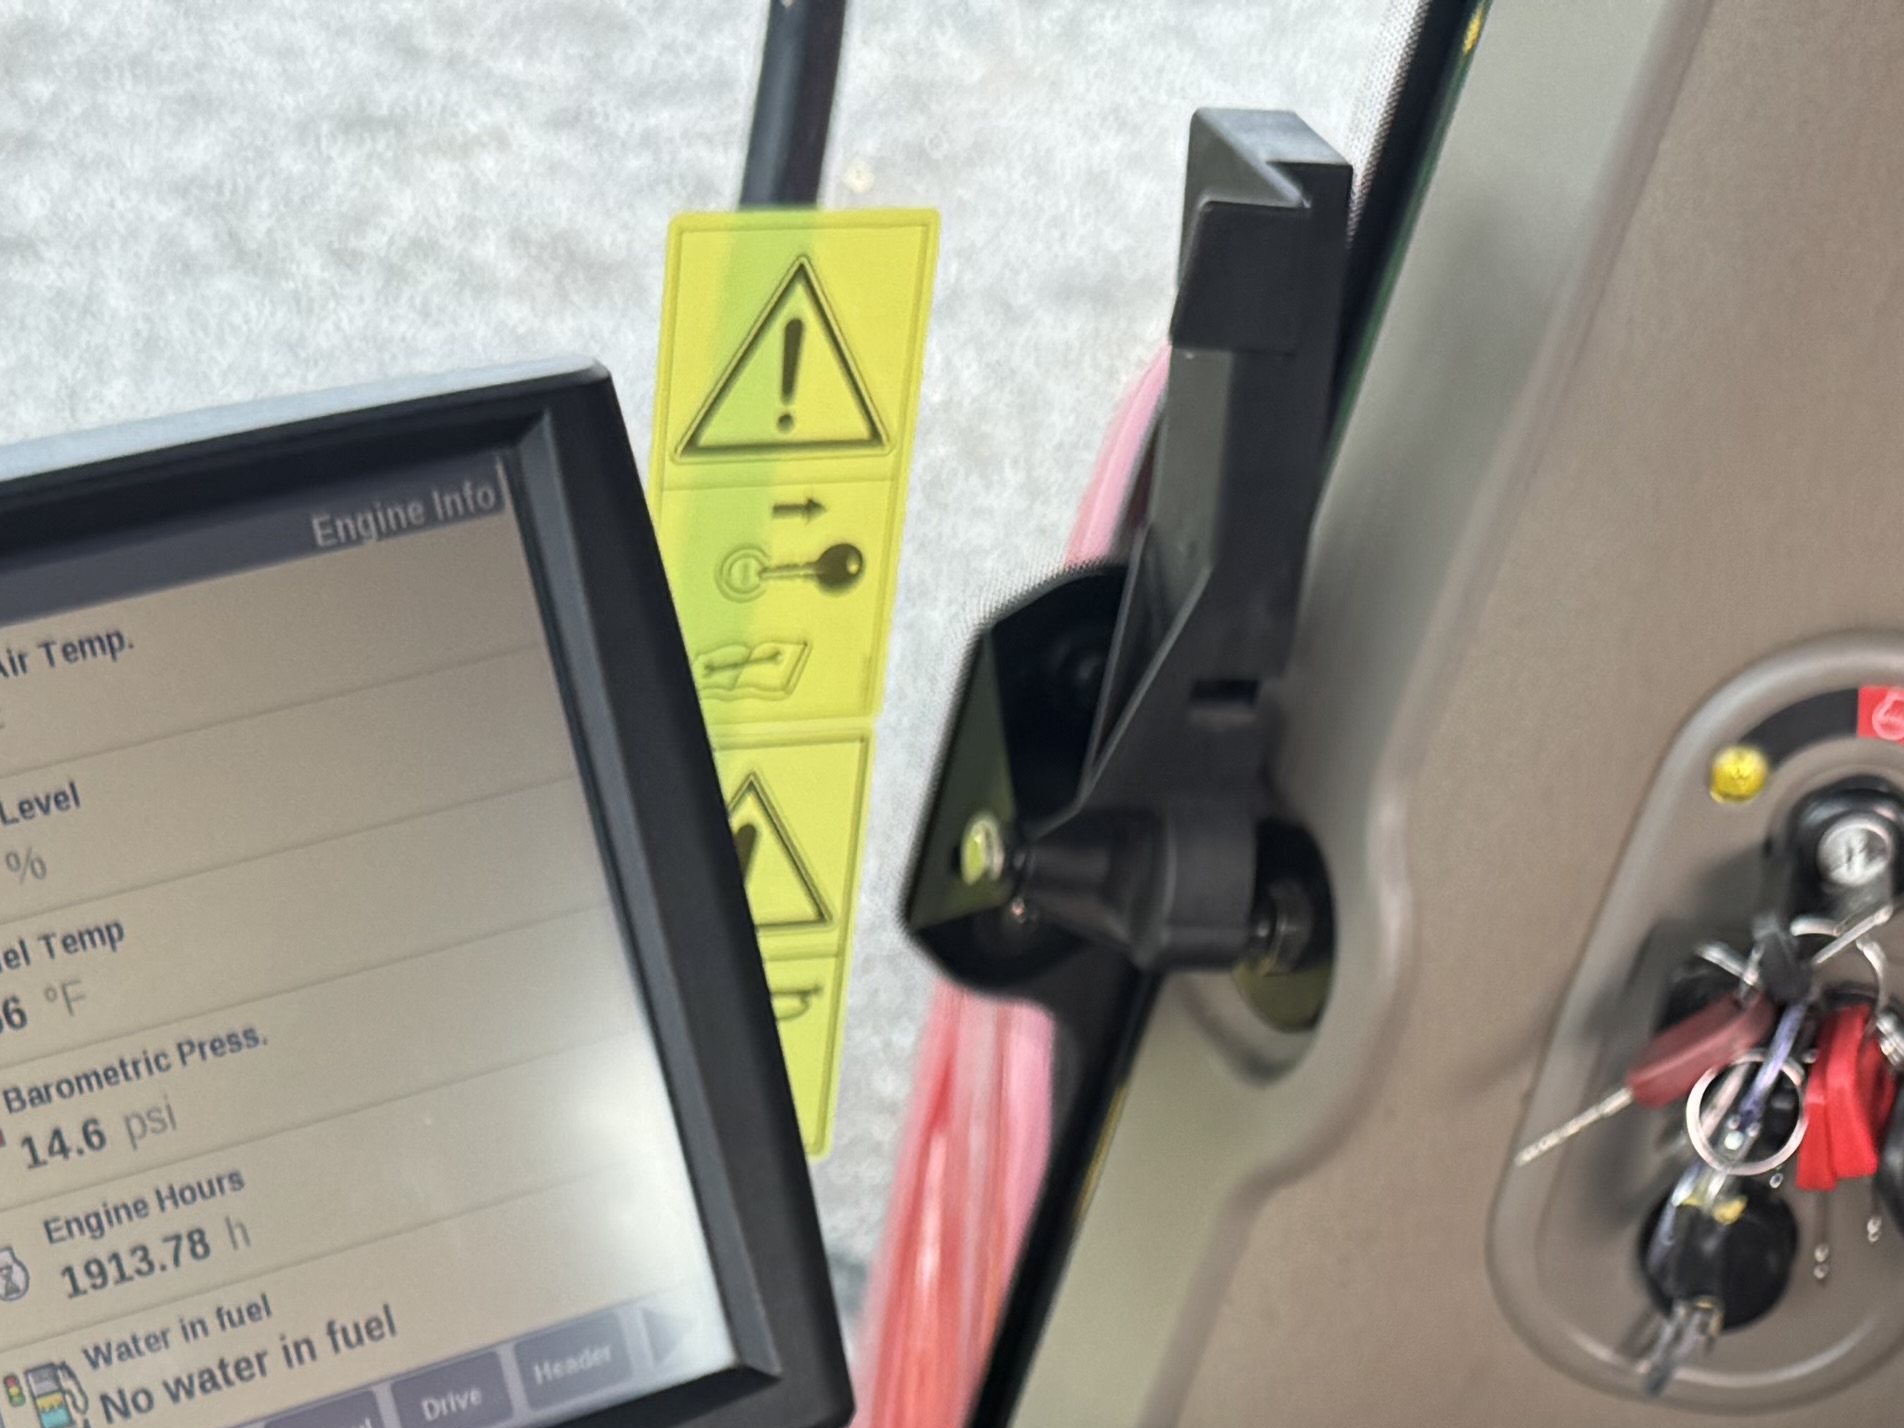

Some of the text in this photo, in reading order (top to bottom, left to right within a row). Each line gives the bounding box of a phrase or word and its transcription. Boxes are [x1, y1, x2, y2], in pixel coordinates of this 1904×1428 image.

[312, 481, 496, 548] Engine Info
[37, 626, 135, 676] Temp.
[5, 849, 47, 884] %
[38, 917, 126, 968] Temp
[1, 1024, 269, 1116] Barometric Press.
[20, 1094, 178, 1171] 14.6 psi
[43, 1165, 247, 1245] Engine Hours
[60, 1217, 252, 1302] 1913.78 h
[82, 1293, 274, 1374] Water in fuel
[98, 1304, 397, 1426] No water in fuel
[532, 1341, 613, 1385] Header
[420, 1384, 483, 1423] Drive
